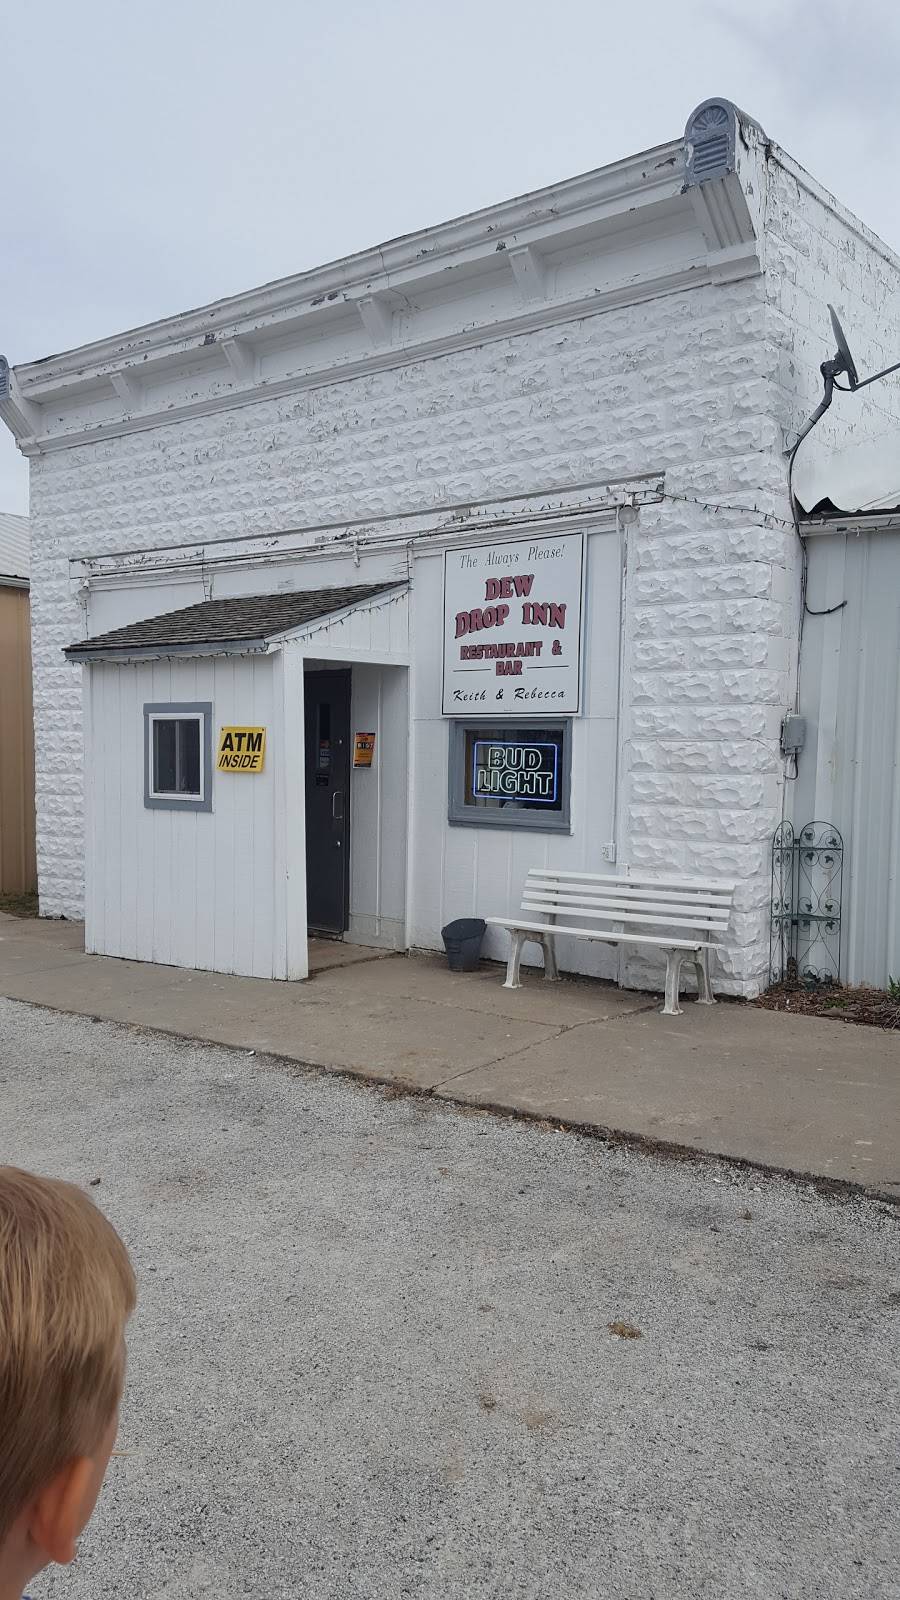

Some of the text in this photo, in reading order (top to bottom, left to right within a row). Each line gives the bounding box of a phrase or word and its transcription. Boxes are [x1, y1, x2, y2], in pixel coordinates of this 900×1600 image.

[460, 544, 565, 569] The Always Please!
[485, 574, 535, 601] DEW
[455, 602, 567, 639] DROP INN
[460, 640, 563, 660] RESTAURANT &
[495, 660, 523, 676] BAR
[453, 687, 566, 701] Keith & Rebecca
[221, 733, 263, 752] ATM
[219, 754, 261, 768] INSIDE
[488, 747, 542, 770] BUD
[477, 770, 553, 795] LIGHT
